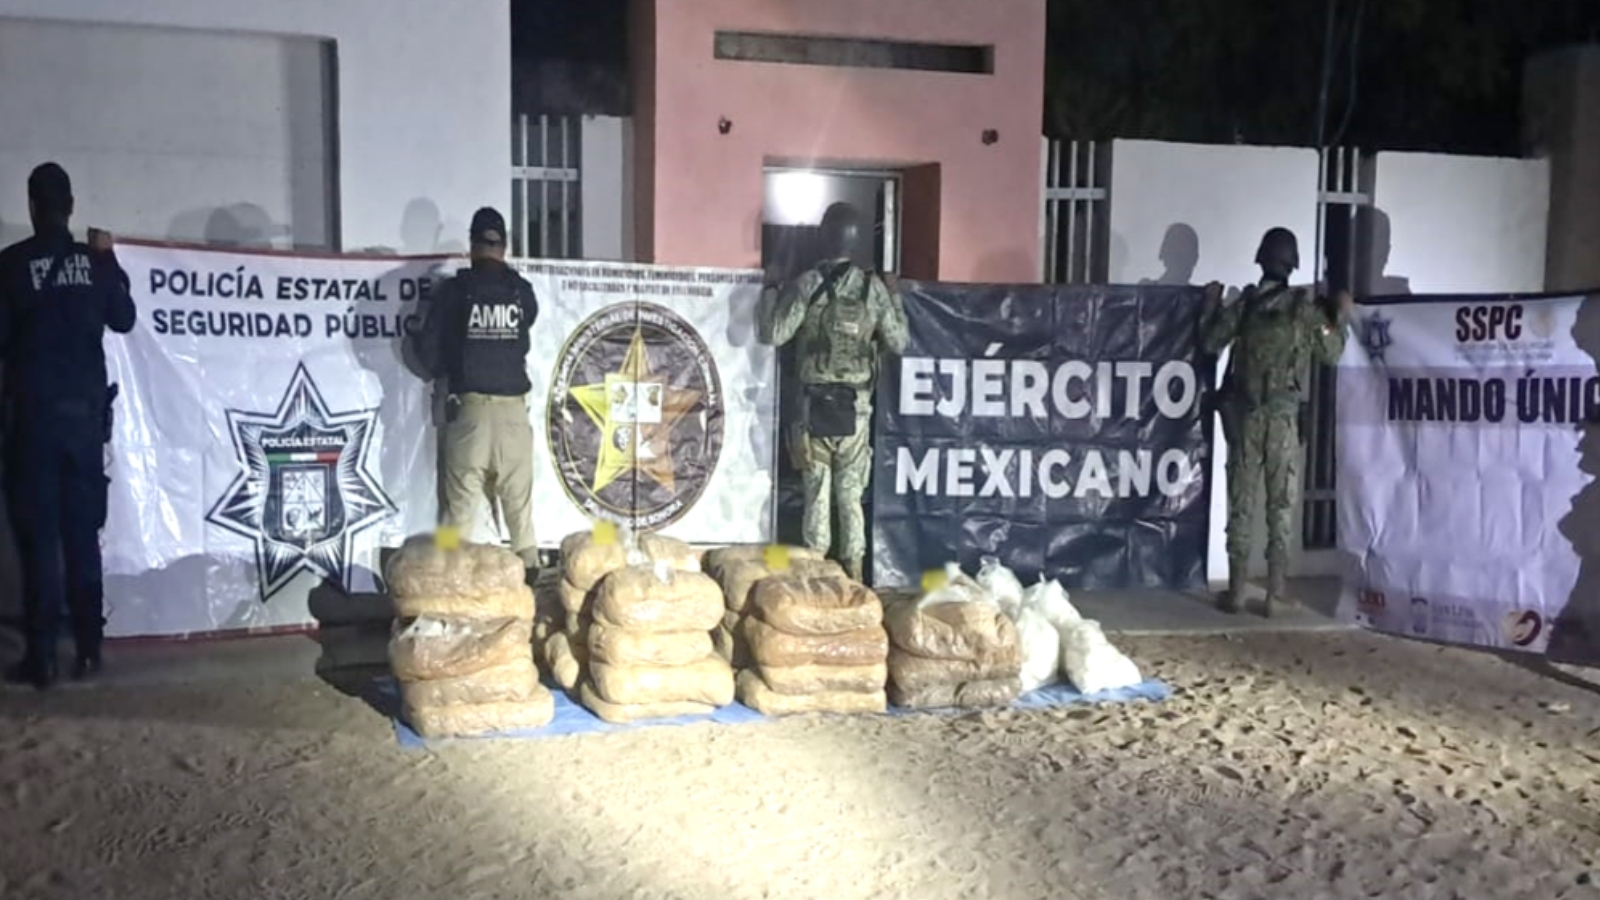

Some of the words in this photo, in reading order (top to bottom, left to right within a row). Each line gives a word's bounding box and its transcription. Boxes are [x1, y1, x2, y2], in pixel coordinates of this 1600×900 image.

[32, 268, 93, 290] EATAL
[149, 266, 264, 299] POLICÍA
[276, 276, 387, 301] ESTATAL
[400, 277, 432, 301] DE
[152, 308, 312, 338] SEGURIDAD
[468, 304, 519, 328] AMIC
[1455, 304, 1524, 342] SSPC
[900, 343, 1196, 419] EJÉRCITO
[1387, 377, 1506, 423] MANDO
[895, 446, 1190, 499] MEXICANO
